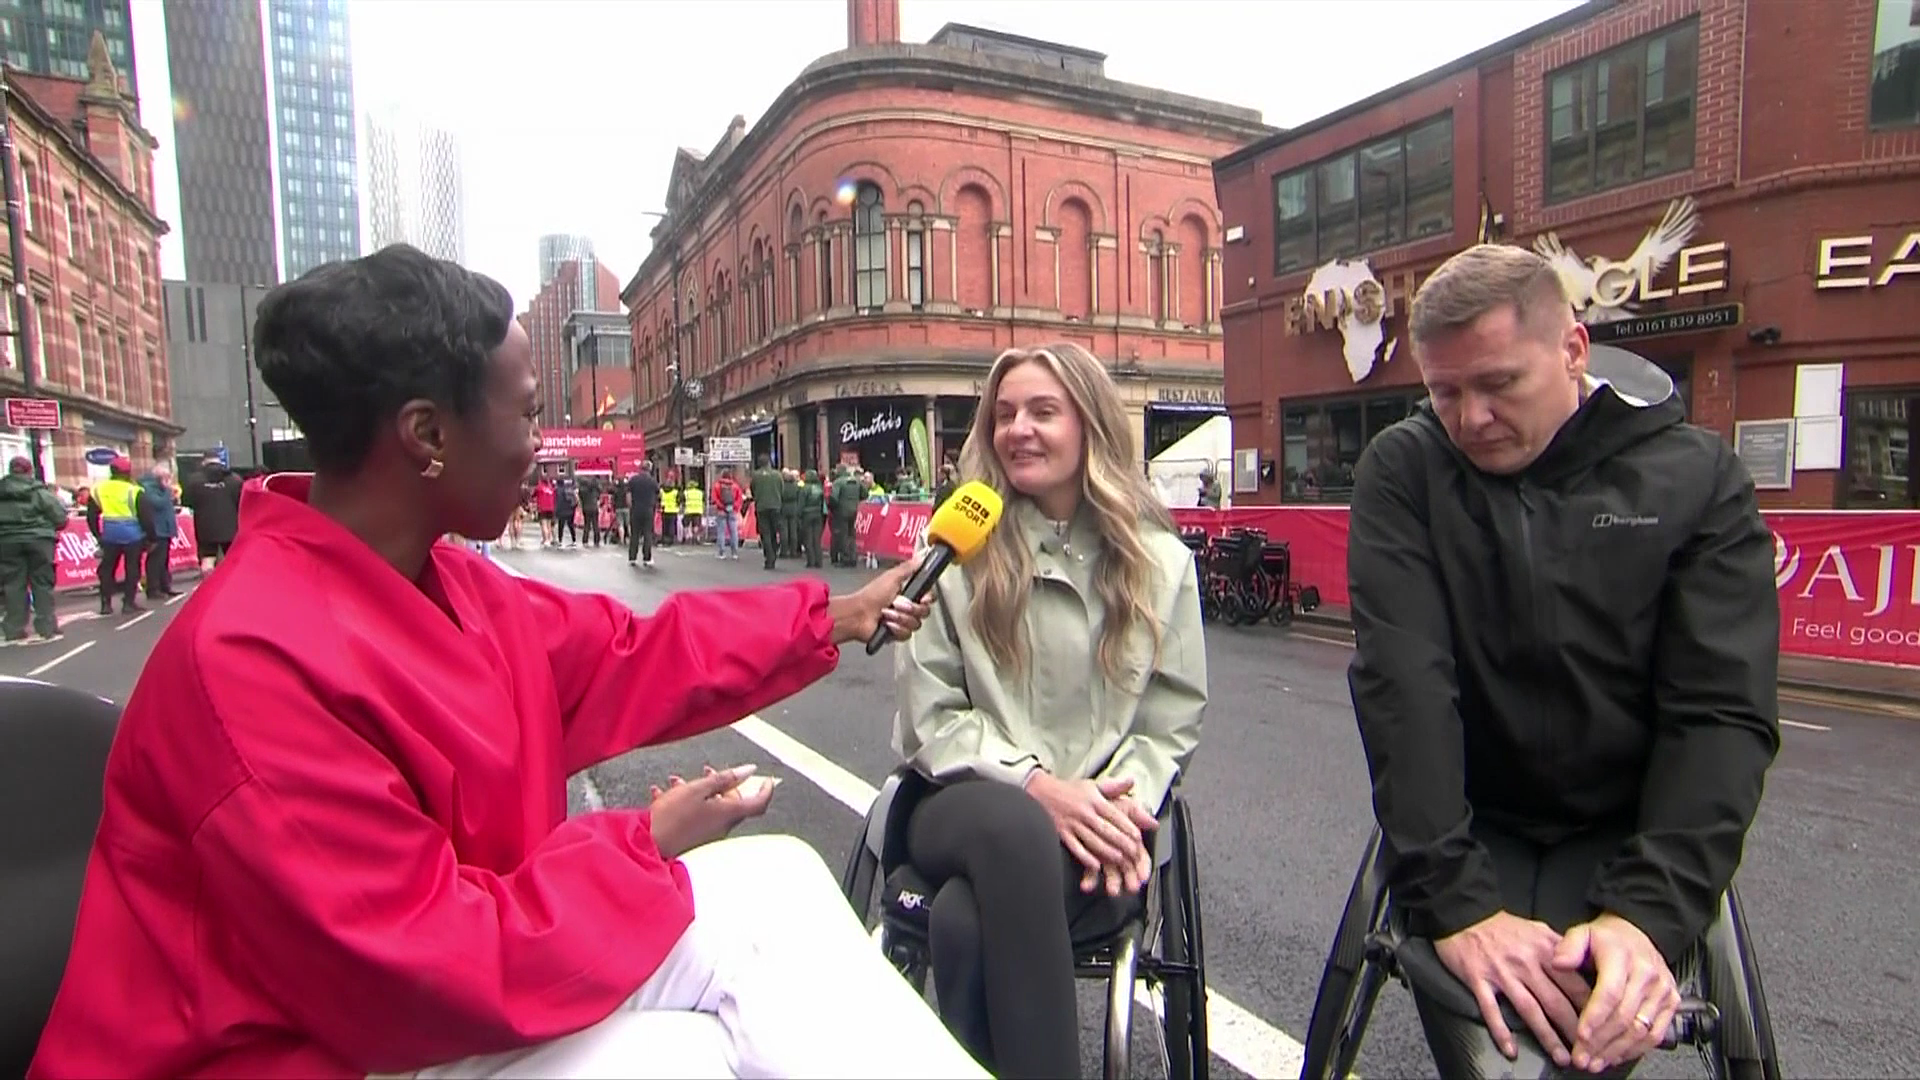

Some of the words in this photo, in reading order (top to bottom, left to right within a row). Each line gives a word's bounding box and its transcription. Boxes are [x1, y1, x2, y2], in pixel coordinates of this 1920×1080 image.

[1592, 242, 1726, 307] GLE
[1635, 320, 1667, 334] 0161
[1669, 315, 1694, 329] 839
[1696, 310, 1730, 325] 8951
[834, 381, 904, 397] TAVERNA
[952, 502, 986, 528] SPORT
[1797, 544, 1920, 617] AJ
[1792, 618, 1841, 640] Feel
[1850, 626, 1920, 646] good
